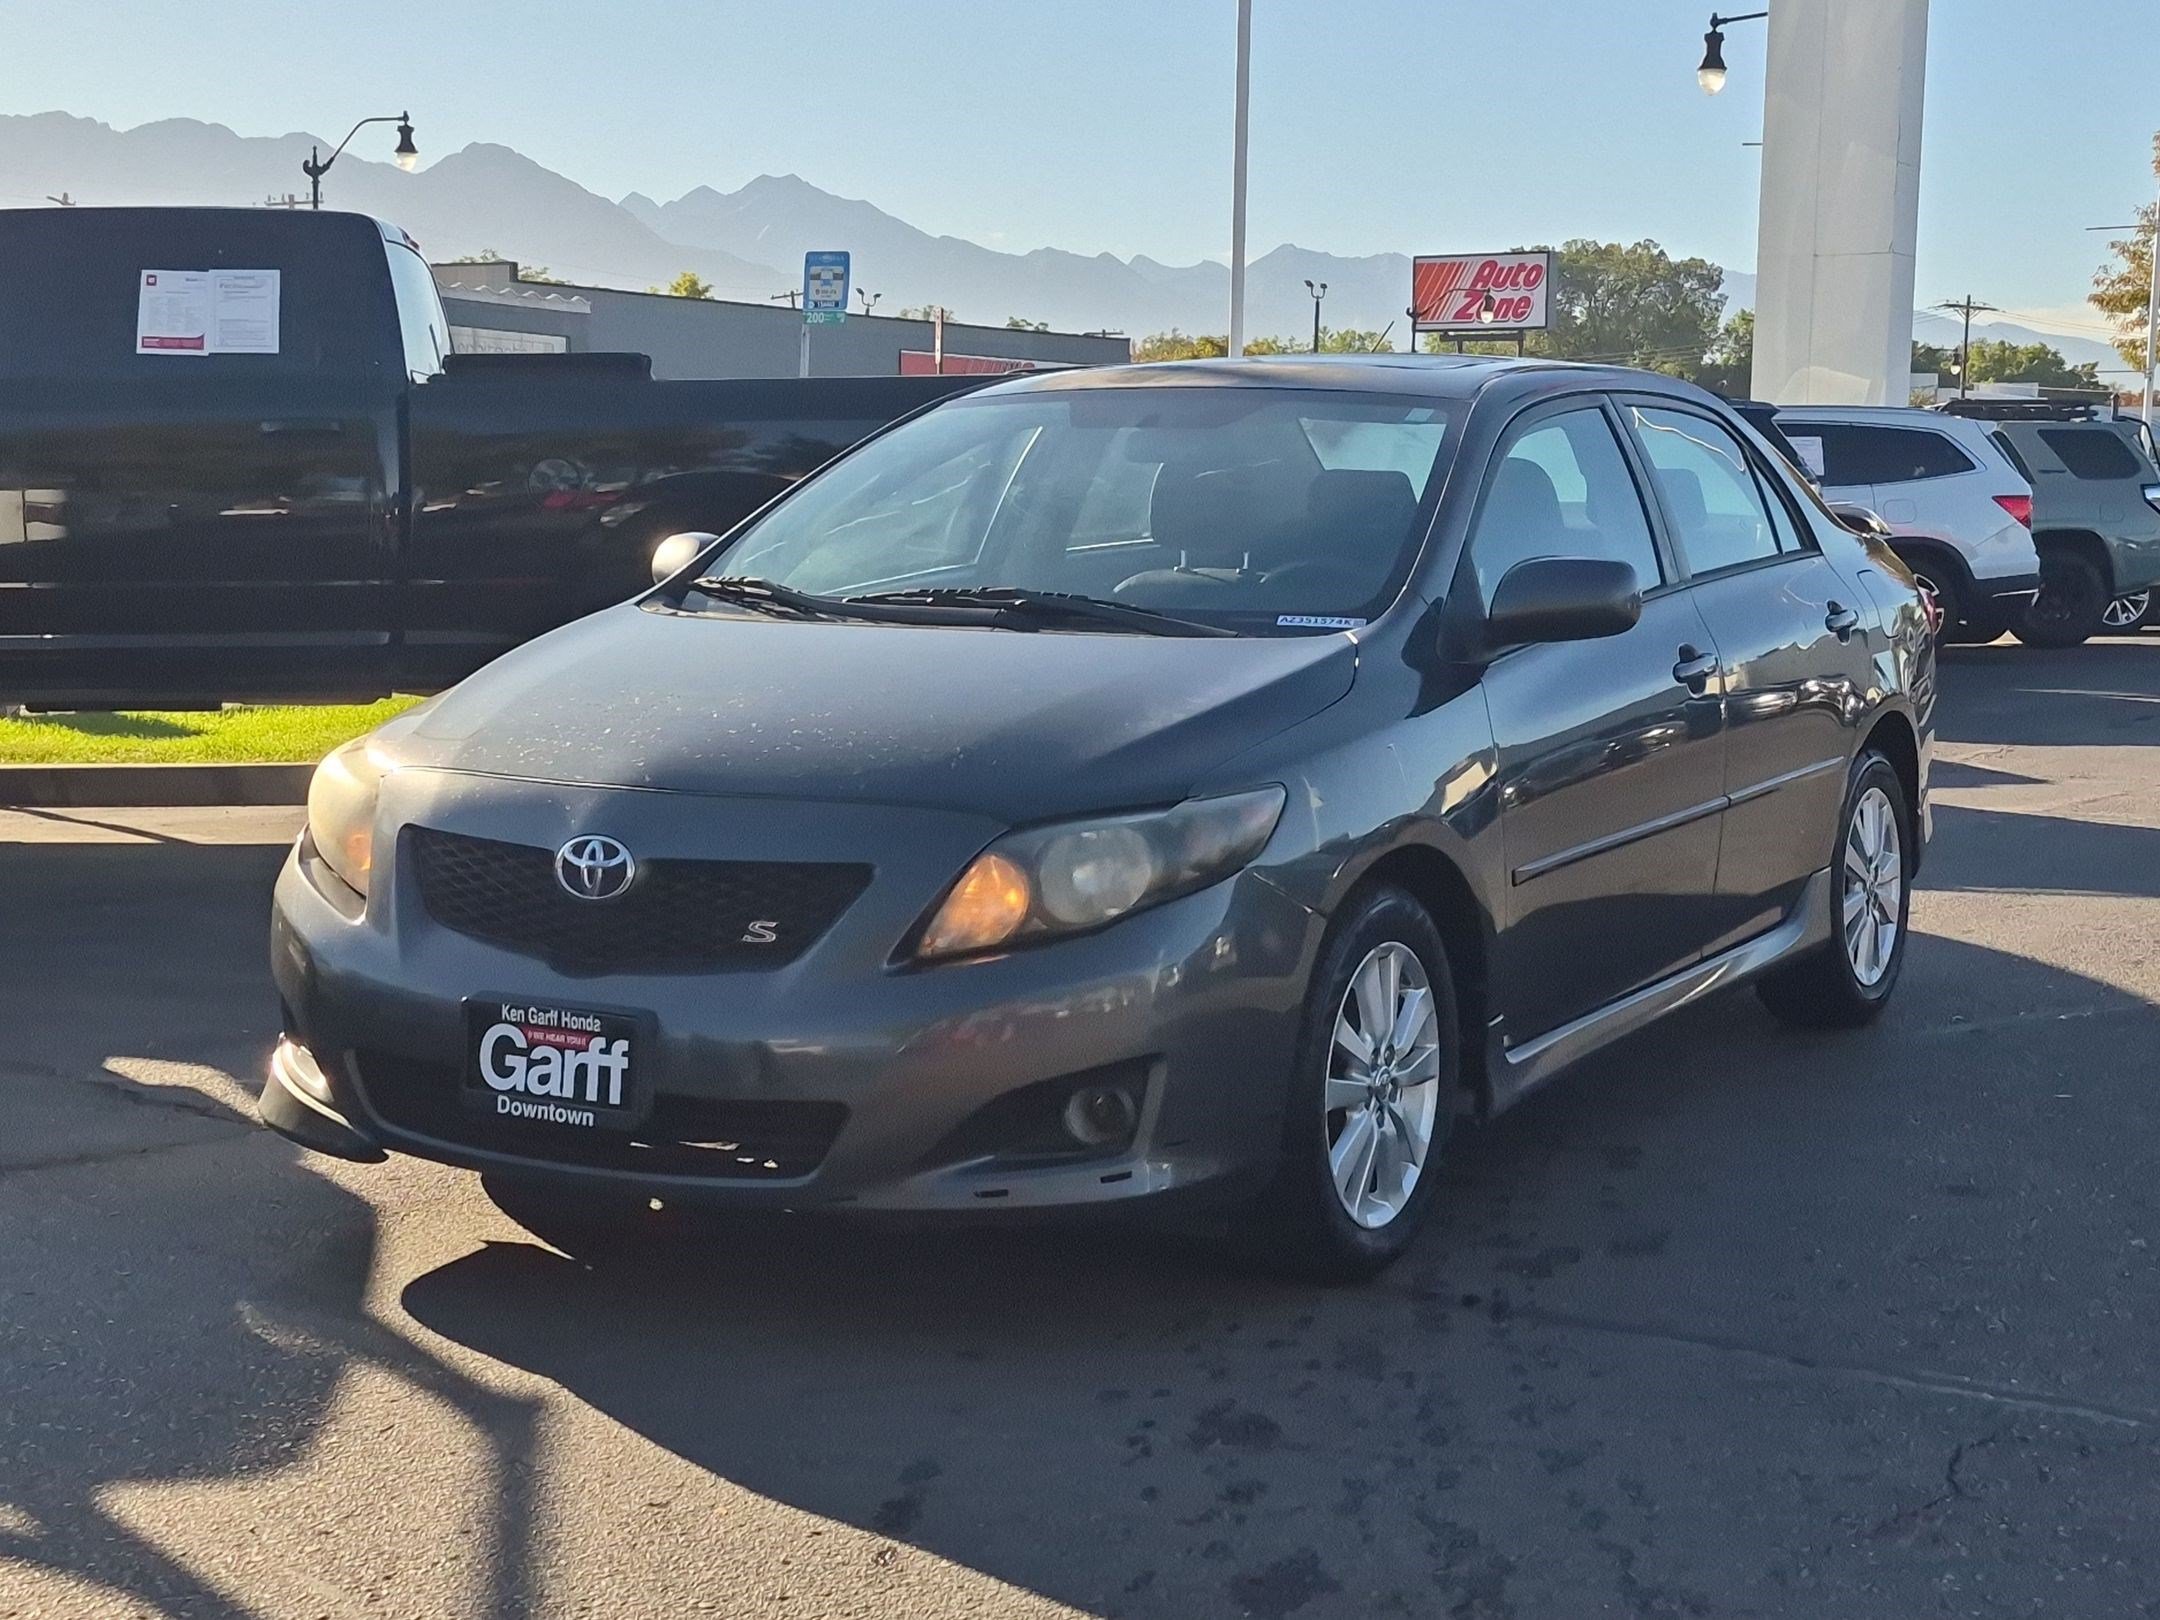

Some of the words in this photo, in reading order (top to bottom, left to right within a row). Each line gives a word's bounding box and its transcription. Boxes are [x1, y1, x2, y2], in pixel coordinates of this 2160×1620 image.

[1469, 260, 1544, 289] Auto
[806, 312, 825, 324] 200
[1453, 289, 1532, 320] Zne
[742, 920, 779, 943] S
[502, 1003, 525, 1023] Ken
[528, 1006, 559, 1027] Garff
[561, 1010, 601, 1032] Honda
[533, 1031, 545, 1040] WE
[546, 1033, 566, 1043] HEAR
[479, 1022, 630, 1105] Garff
[497, 1094, 595, 1127] Downtown
